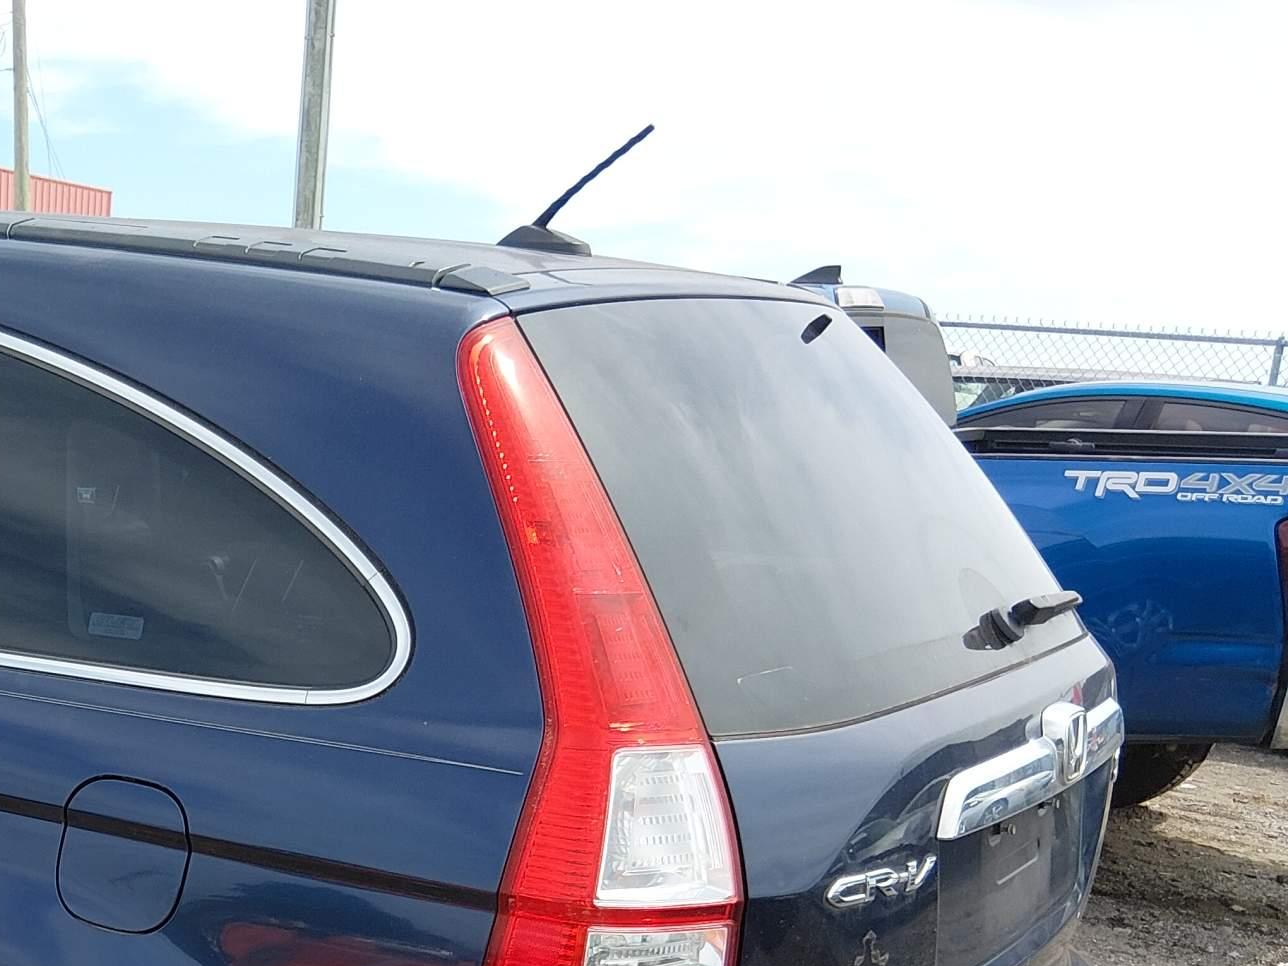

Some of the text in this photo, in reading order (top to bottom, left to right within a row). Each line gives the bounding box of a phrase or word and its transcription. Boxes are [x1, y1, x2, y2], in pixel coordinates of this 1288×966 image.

[1064, 470, 1180, 500] TRD
[1176, 492, 1285, 506] OFF ROAD
[826, 855, 937, 908] CR-V
